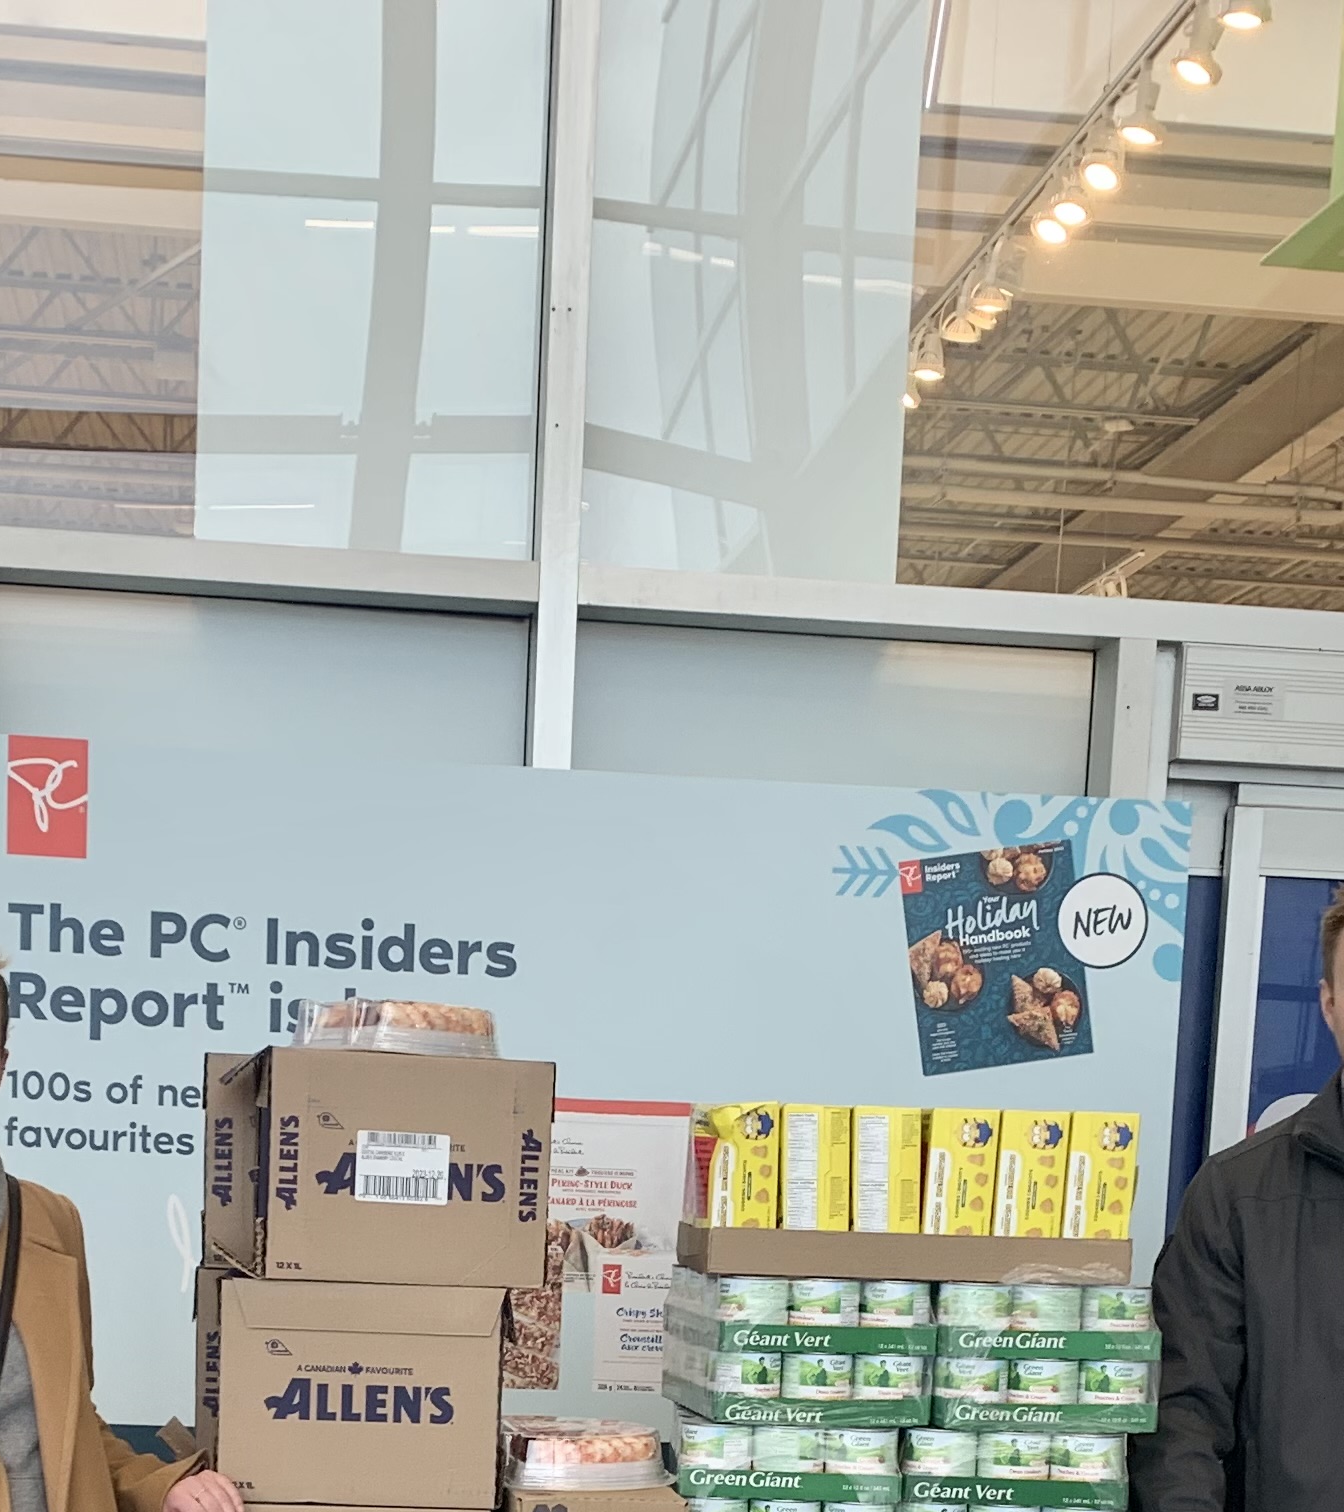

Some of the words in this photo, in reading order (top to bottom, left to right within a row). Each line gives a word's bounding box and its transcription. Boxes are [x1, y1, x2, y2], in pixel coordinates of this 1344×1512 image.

[924, 862, 960, 873] Insiders
[945, 896, 1040, 939] Holiday
[1072, 904, 1133, 940] NEW
[8, 903, 124, 957] The
[266, 918, 517, 978] Insiders
[960, 925, 1031, 946] Handbook
[7, 1070, 91, 1103] 100s
[106, 1075, 143, 1106] of
[158, 1083, 202, 1108] ne
[5, 1117, 194, 1155] favourites
[212, 1116, 234, 1207] ALLEN'S
[276, 1114, 299, 1211] ALLEN'S
[315, 1152, 506, 1203] AN'S
[518, 1129, 542, 1223] ALLEN'S
[616, 1307, 647, 1318] Crispy
[733, 1329, 790, 1347] Géant
[794, 1331, 831, 1347] Vert
[959, 1332, 1014, 1349] Green
[1015, 1332, 1066, 1349] Giant
[304, 1365, 346, 1374] CANADIAN
[365, 1366, 413, 1376] FAVOURITE
[264, 1377, 454, 1425] ALLEN'S
[786, 1406, 823, 1423] Vert
[956, 1405, 1012, 1421] Green
[1012, 1406, 1063, 1423] Giant
[689, 1469, 748, 1486] Green
[749, 1471, 802, 1488] Giant
[914, 1482, 971, 1500] Géant
[975, 1484, 1014, 1501] Vert
